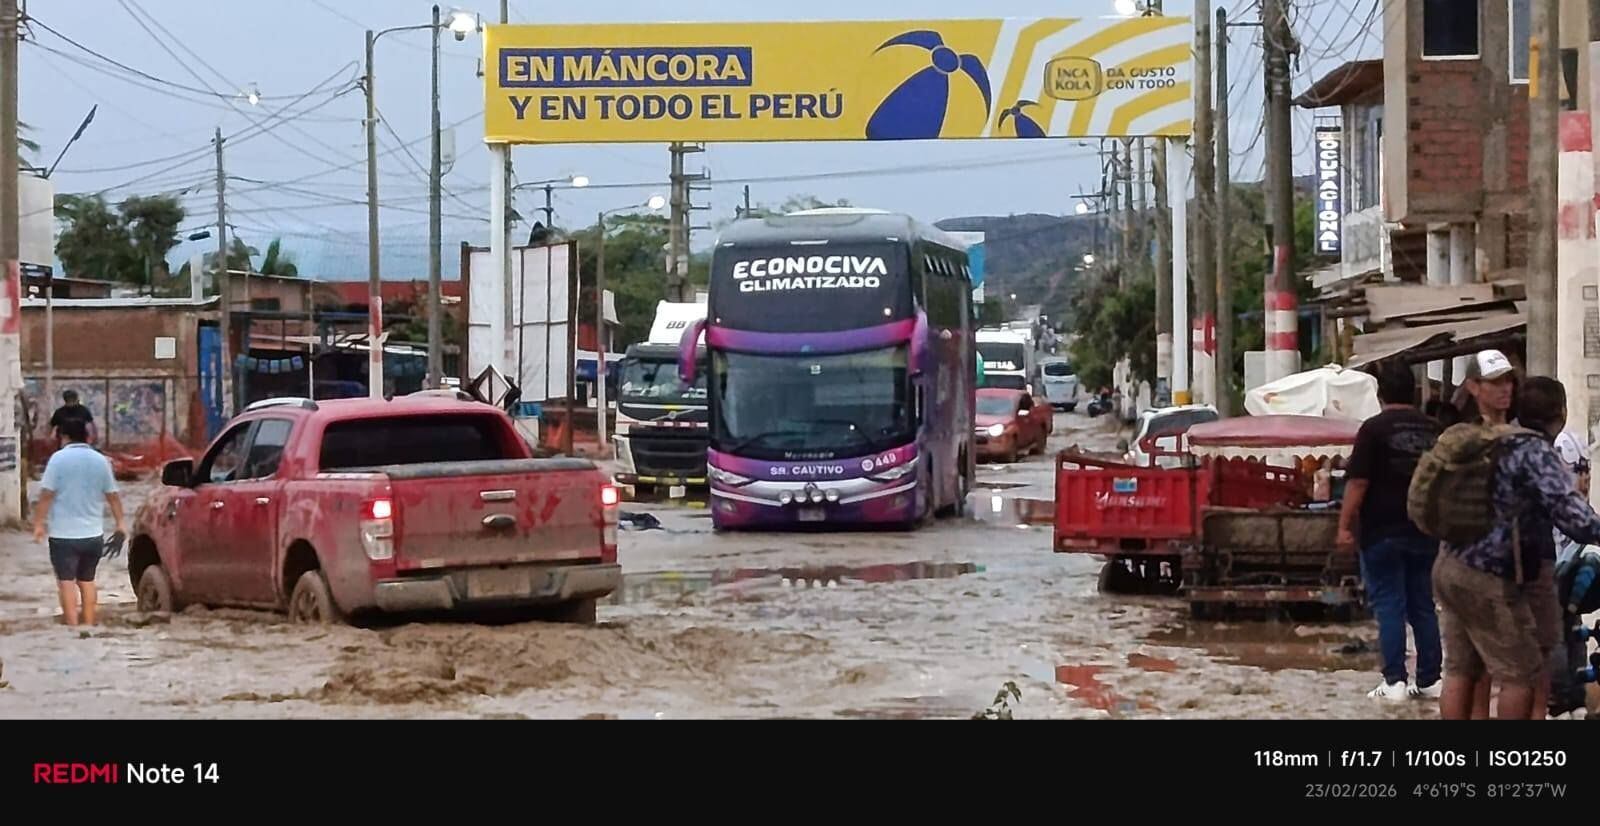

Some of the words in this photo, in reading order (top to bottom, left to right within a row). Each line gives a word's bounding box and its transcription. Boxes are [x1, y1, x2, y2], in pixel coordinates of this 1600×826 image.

[506, 55, 554, 82] EN
[562, 49, 746, 81] MÁNCORA
[1106, 67, 1125, 77] DA
[1129, 66, 1176, 77] GUSTO
[1057, 67, 1089, 78] INCA
[1055, 80, 1092, 90] KOLA
[1106, 79, 1135, 89] CON
[1138, 78, 1176, 89] TODO
[508, 95, 533, 120] Y
[541, 95, 587, 120] EN
[594, 94, 694, 120] TODO
[701, 94, 742, 119] EL
[750, 88, 843, 119] PERÚ
[1319, 140, 1339, 251] OCUPACIONAL
[733, 255, 888, 279] ECONOCIVA
[739, 276, 881, 292] CLIMATIZADO
[792, 465, 844, 475] CAUTIVO
